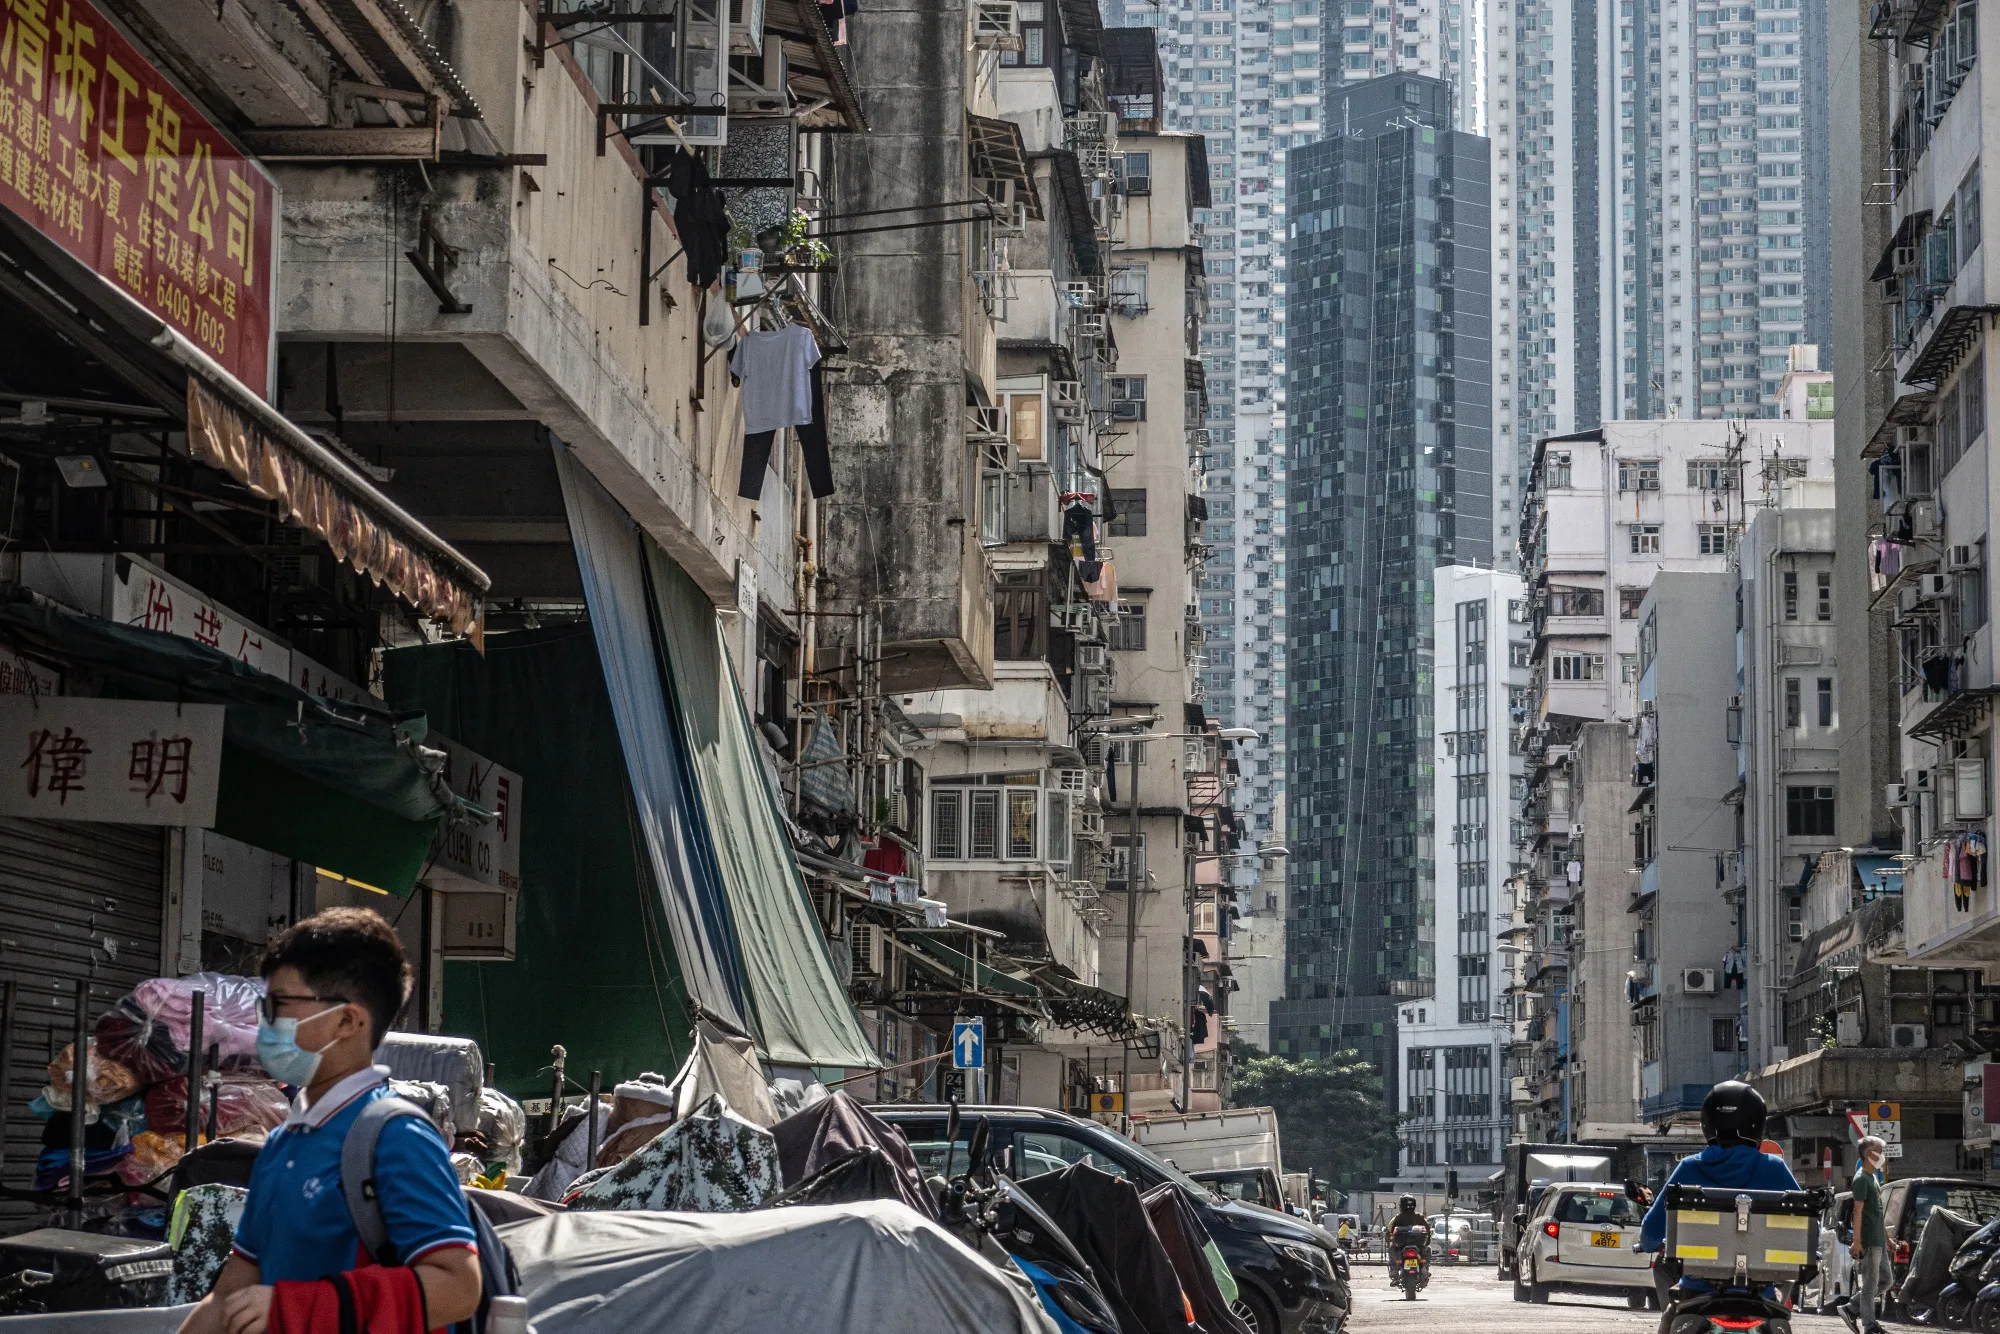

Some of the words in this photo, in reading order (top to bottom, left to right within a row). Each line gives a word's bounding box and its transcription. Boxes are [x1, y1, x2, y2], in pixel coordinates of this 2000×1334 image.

[156, 273, 190, 327] 6409
[193, 303, 225, 355] 7603
[20, 727, 192, 806] 偉明
[946, 1074, 962, 1086] 24
[1889, 1121, 1896, 1130] 7
[1889, 1133, 1896, 1141] 7
[1599, 1232, 1612, 1240] SG
[1595, 1239, 1617, 1247] 4817
